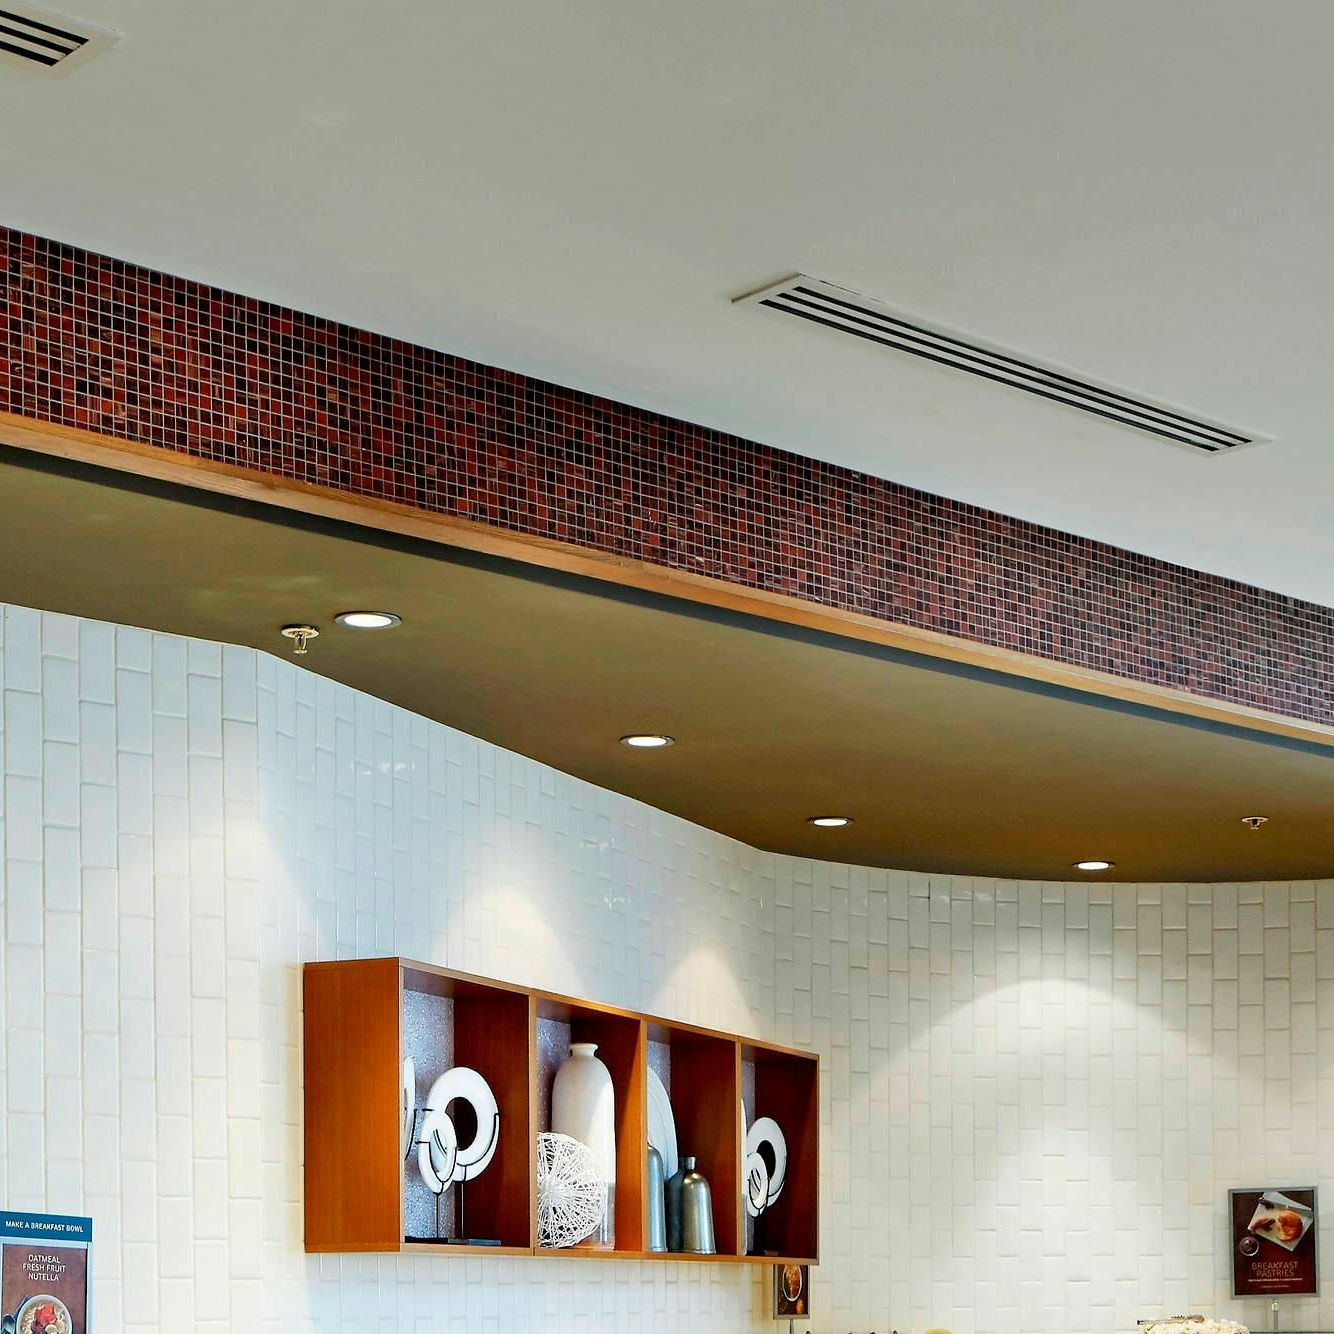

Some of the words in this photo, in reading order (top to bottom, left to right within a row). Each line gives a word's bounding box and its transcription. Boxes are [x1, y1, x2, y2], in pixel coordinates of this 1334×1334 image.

[5, 1220, 24, 1229] MAKE
[30, 1222, 65, 1231] BREAKFAST
[66, 1224, 84, 1233] BOWL
[28, 1254, 61, 1263] OATMEAL
[22, 1263, 45, 1271] FRESH
[46, 1264, 66, 1272] FRUIT
[1251, 1261, 1299, 1270] BREAKFAST
[28, 1272, 60, 1281] NUTELLA
[1256, 1268, 1295, 1277] PASTRIES
